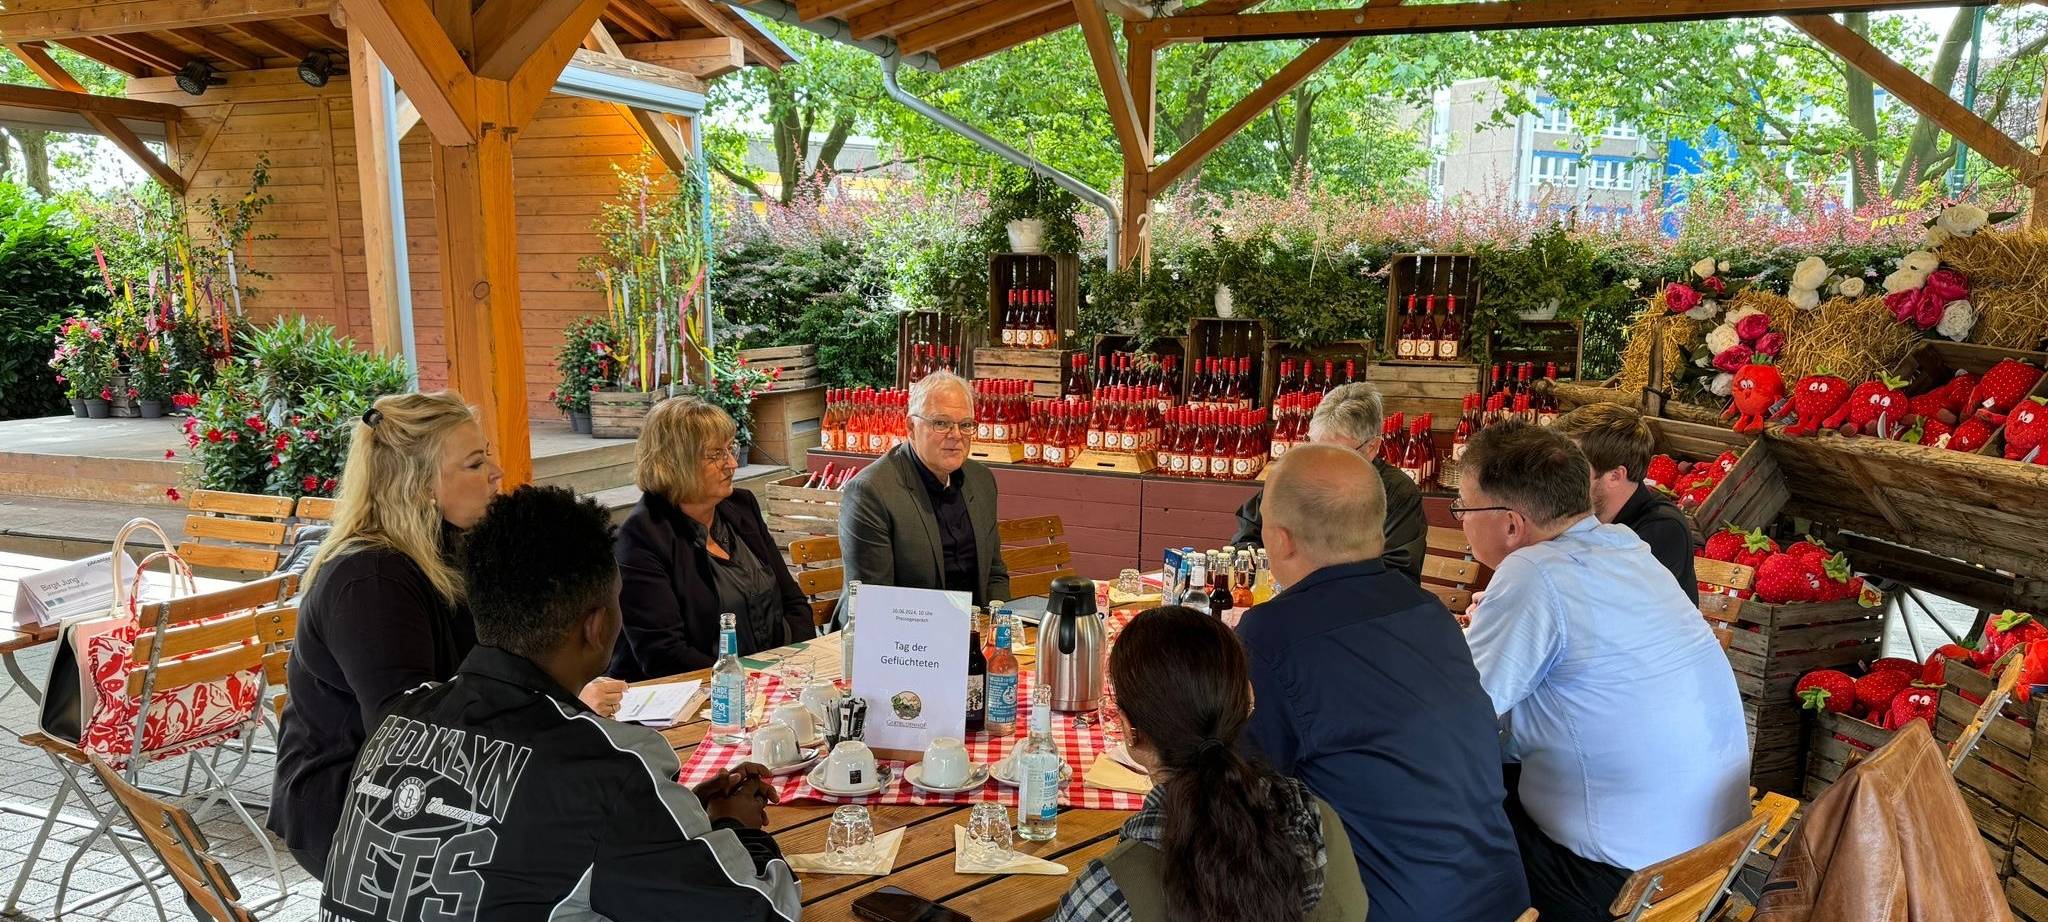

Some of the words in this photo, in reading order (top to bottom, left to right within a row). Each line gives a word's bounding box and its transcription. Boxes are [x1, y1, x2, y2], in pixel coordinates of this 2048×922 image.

[40, 580, 61, 592] Birgit
[62, 576, 80, 586] Jung
[894, 641, 910, 652] Tag
[911, 642, 928, 652] der
[880, 655, 940, 669] Geflüchteten
[352, 715, 533, 824] BROOKLYN
[425, 797, 492, 825] CONFERENCE
[321, 783, 498, 922] NETS
